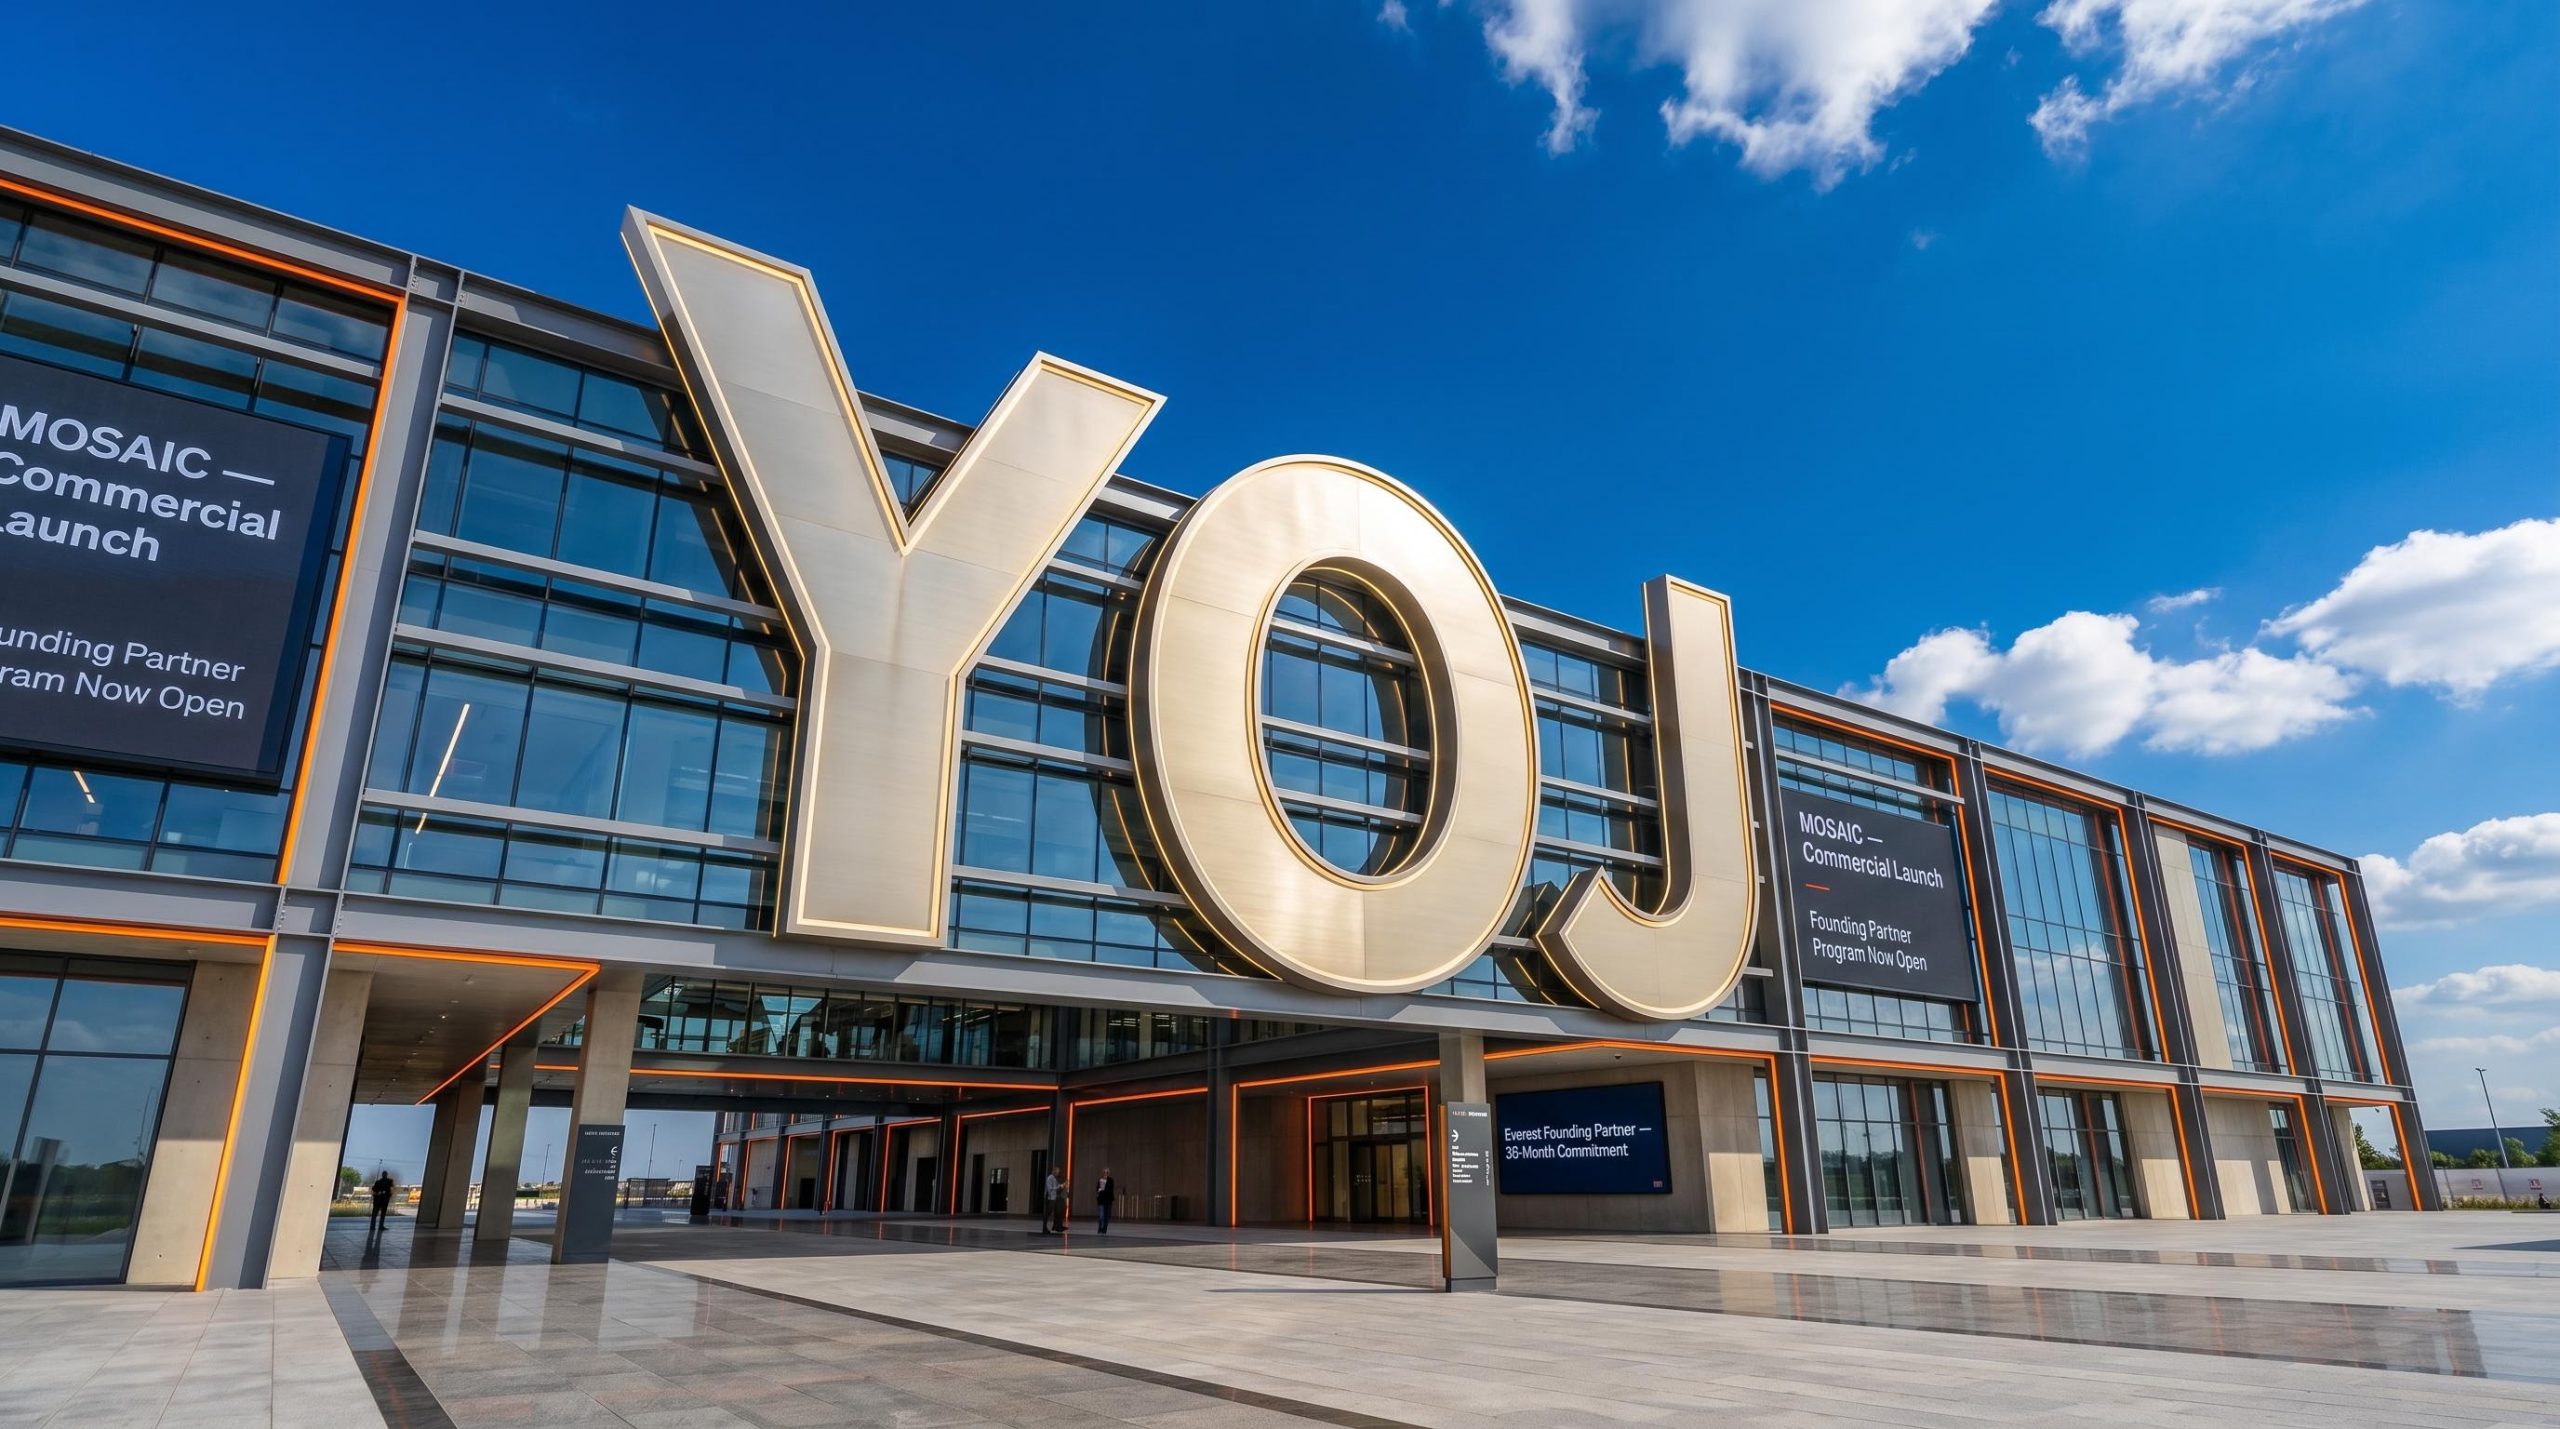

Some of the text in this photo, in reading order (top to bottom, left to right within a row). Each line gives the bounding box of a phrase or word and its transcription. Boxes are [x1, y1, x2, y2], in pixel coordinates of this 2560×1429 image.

[0, 404, 212, 479] MOSAIC
[0, 451, 281, 541] Commercial
[0, 511, 160, 562] aunch
[620, 204, 1757, 1022] YOJ
[123, 641, 246, 682] Partner
[74, 671, 152, 705] Now
[159, 686, 245, 720] Open
[1799, 811, 1863, 845] MOSAIC
[1802, 841, 1944, 889] Commercial Launch
[1809, 909, 1912, 944] Founding Partner
[1812, 937, 1928, 974] Program Now Open
[1504, 1127, 1543, 1142] Everest
[1543, 1124, 1592, 1142] Founding
[1594, 1123, 1637, 1138] Partner
[1505, 1143, 1629, 1160] 36-Month Commitment
